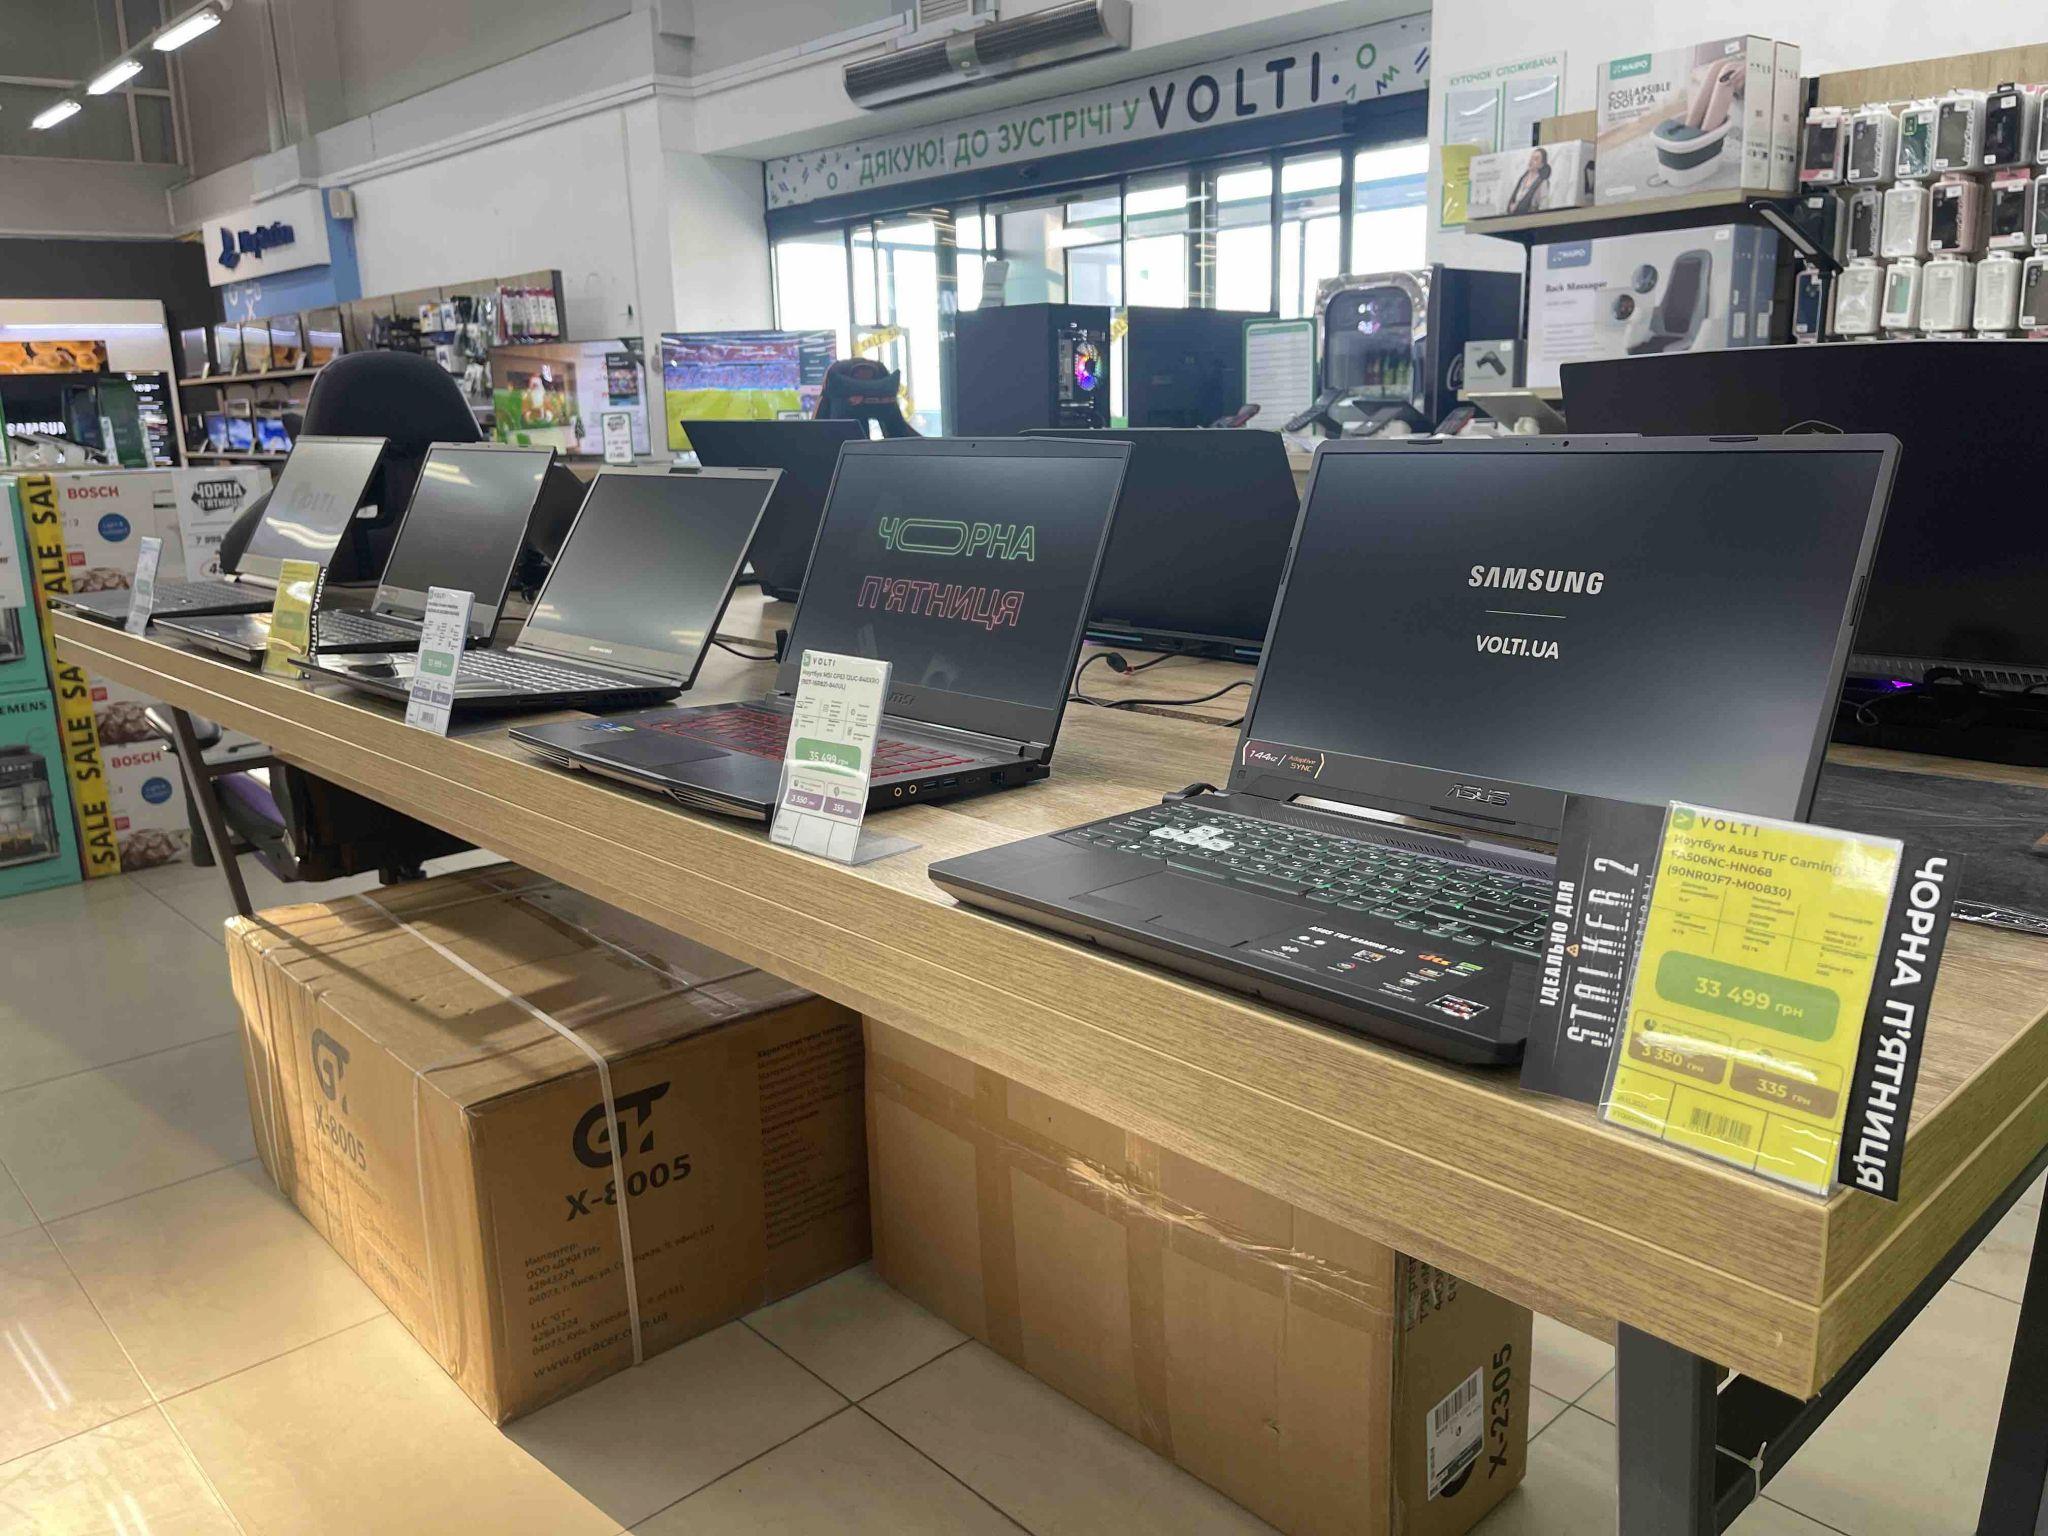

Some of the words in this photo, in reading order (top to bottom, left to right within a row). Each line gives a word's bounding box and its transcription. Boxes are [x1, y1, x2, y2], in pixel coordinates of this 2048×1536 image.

[1450, 71, 1491, 87] КУТОЧОК
[1496, 56, 1559, 77] СПОЖИВАЧА
[1608, 81, 1671, 101] COLLAPSIBLE
[1608, 98, 1634, 111] FOOT
[1637, 94, 1656, 107] SPA
[859, 136, 945, 186] ДЯКУЮ!
[954, 129, 989, 168] ДО
[998, 102, 1112, 154] ЗУСТРІЧІ
[1122, 97, 1140, 130] У
[1149, 51, 1320, 129] VOLTI
[67, 485, 119, 499] BOSCH
[195, 482, 243, 499] ЧОРНА
[878, 516, 1036, 562] ЧОРНА
[1468, 564, 1605, 595] SAMSUNG
[857, 575, 1026, 630] П'ЯТНИЦЯ
[812, 656, 836, 667] VOLTI
[1476, 634, 1559, 660] VOLTI.UA
[67, 716, 101, 781] SALE
[111, 751, 162, 769] BOSCH
[808, 750, 820, 761] 35
[821, 752, 837, 765] 499
[1290, 762, 1314, 773] SYNC
[83, 799, 117, 866] SALE
[1701, 816, 1760, 838] VOLTI
[1593, 857, 1640, 877] 2
[1671, 849, 1774, 878] FA506NC-HN068
[1674, 833, 1727, 854] Ноутбук
[1728, 844, 1759, 859] Asus
[1761, 850, 1788, 864] TUF
[1789, 856, 1843, 878] Gaming
[1889, 857, 1948, 988] ЧОРНА
[1539, 921, 1569, 1006] ІДЕАЛЬНО
[1555, 880, 1576, 918] ДЛЯ
[1694, 976, 1722, 998] 33
[1726, 985, 1771, 1011] 499
[1774, 1001, 1804, 1019] грн
[1654, 1046, 1684, 1067] 350
[1757, 1078, 1788, 1098] 335
[1791, 1092, 1811, 1107] грн
[1852, 999, 1916, 1193] П'ЯТНИЦЯ
[314, 1102, 367, 1172] X-8005
[565, 1153, 692, 1222] X-8005
[1488, 1342, 1513, 1480] X-2305
